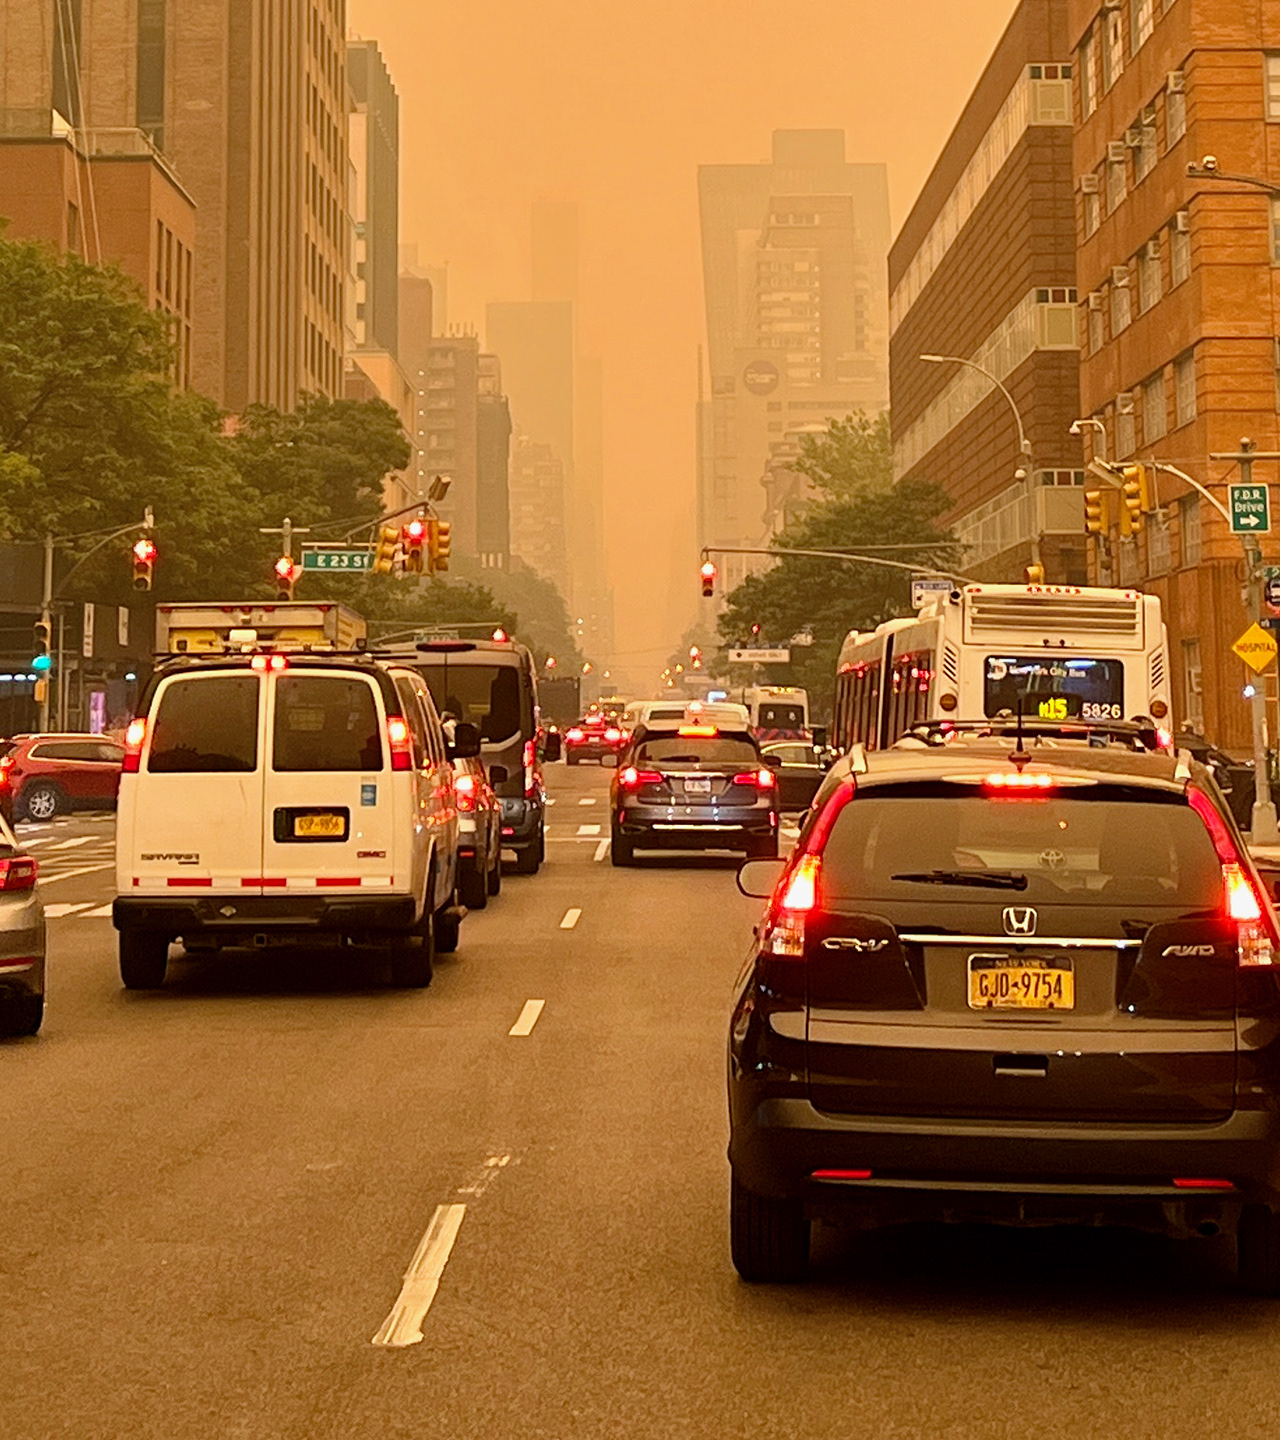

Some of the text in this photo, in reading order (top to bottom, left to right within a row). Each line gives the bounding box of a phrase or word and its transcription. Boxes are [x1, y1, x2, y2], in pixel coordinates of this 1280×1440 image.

[1234, 490, 1263, 500] F.D.R.
[1234, 501, 1265, 512] Drive
[317, 555, 327, 567] E
[330, 555, 349, 567] 23
[1235, 642, 1277, 653] HOSPITAL
[1069, 667, 1087, 678] Bus
[1082, 702, 1121, 719] 5826
[1161, 944, 1216, 957] AWD
